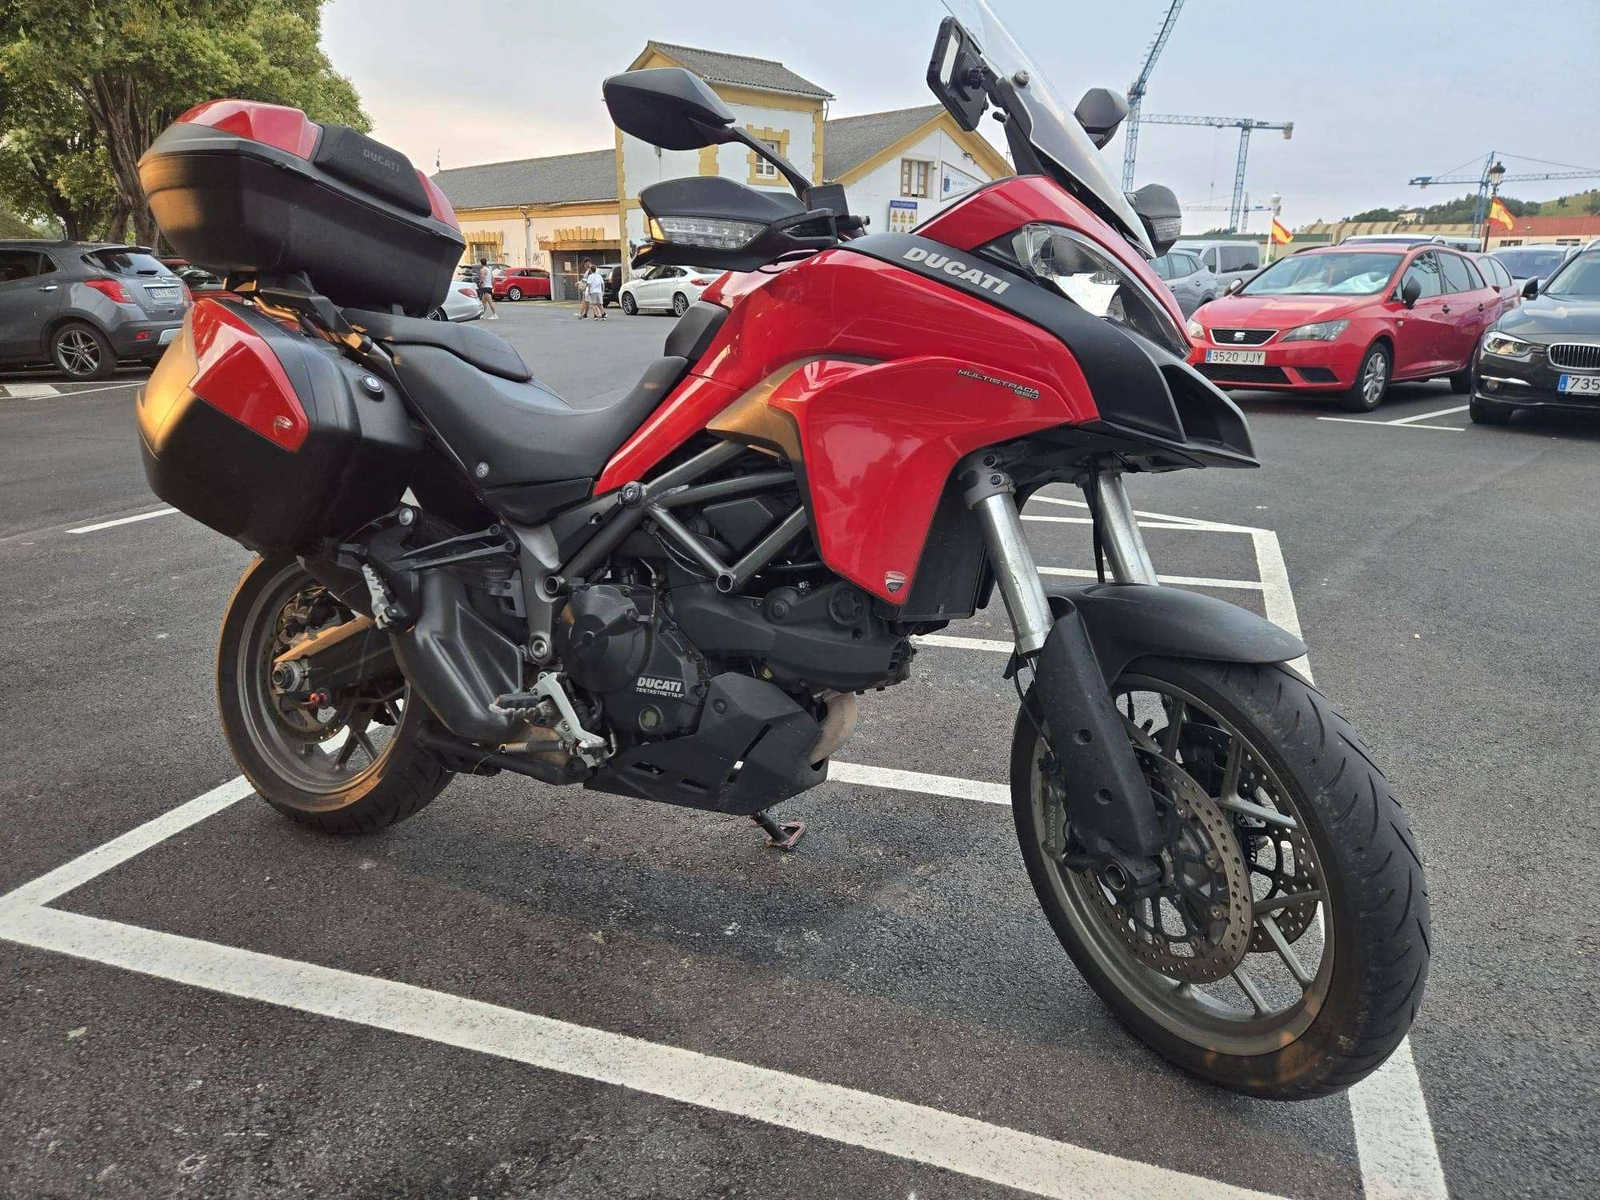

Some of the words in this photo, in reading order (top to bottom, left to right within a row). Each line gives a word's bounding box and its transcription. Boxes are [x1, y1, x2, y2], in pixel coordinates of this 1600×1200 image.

[363, 149, 400, 172] DUCATI
[902, 247, 1011, 295] DUCATI
[1212, 351, 1238, 363] 3520
[1242, 352, 1263, 363] JJY
[957, 369, 1039, 395] MULTISTRADA
[636, 676, 682, 693] DUCATI
